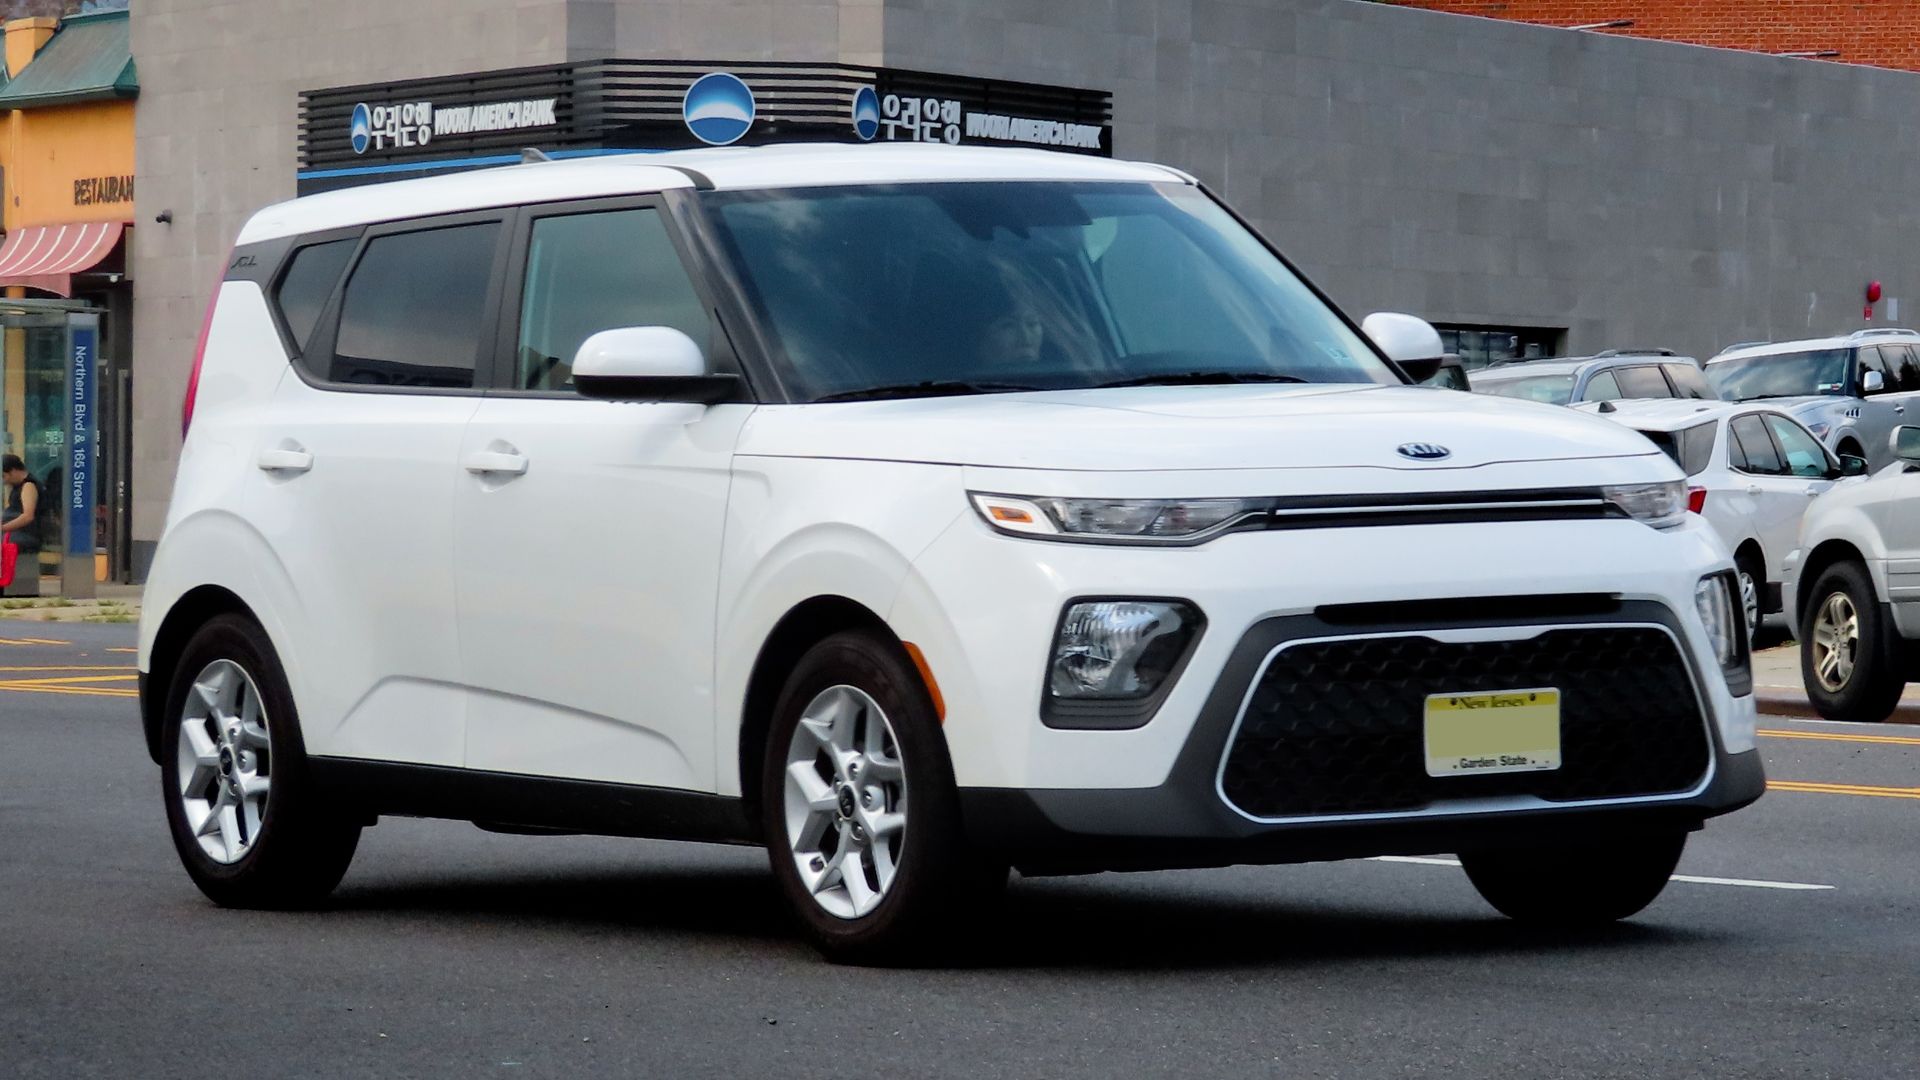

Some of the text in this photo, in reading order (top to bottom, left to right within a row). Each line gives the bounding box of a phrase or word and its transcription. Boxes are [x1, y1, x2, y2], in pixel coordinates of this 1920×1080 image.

[371, 102, 432, 150] 우리은행
[434, 98, 557, 135] WOORI AMERICA BANK
[880, 94, 961, 145] 우리은행
[1009, 118, 1065, 145] AMERICA
[1065, 123, 1102, 148] BANK
[73, 346, 87, 508] Northern Blvd & 165 Street
[1460, 755, 1528, 769] Garden State
